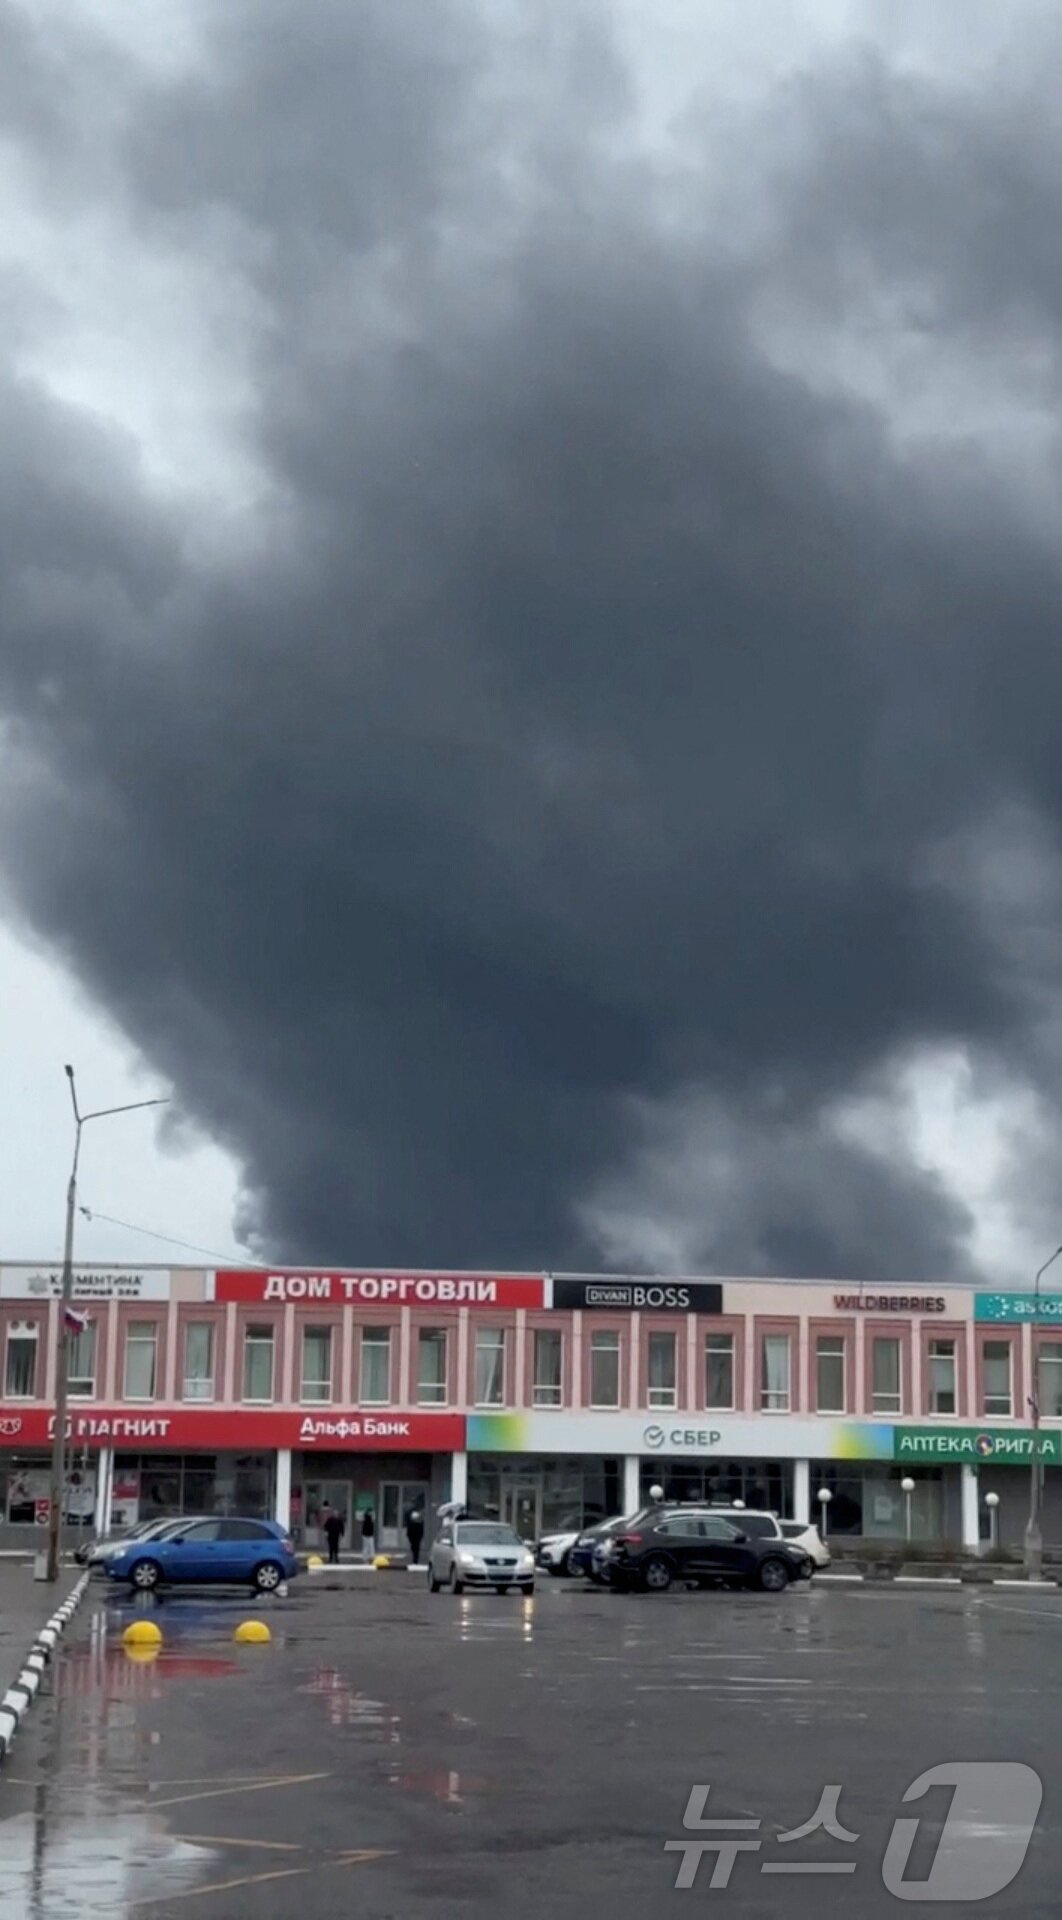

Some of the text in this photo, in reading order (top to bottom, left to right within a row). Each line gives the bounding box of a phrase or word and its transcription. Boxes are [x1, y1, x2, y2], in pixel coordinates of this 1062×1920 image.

[263, 1276, 497, 1301] ДОМ ТОРГОВЛИ
[590, 1287, 690, 1307] DIVAN BOSS
[833, 1295, 946, 1312] WILDBERRIES
[78, 1418, 171, 1436] МАГНИТ
[300, 1417, 410, 1440] Альфа Банк
[669, 1429, 721, 1446] СБЕР
[900, 1436, 974, 1453] АПТЕКА
